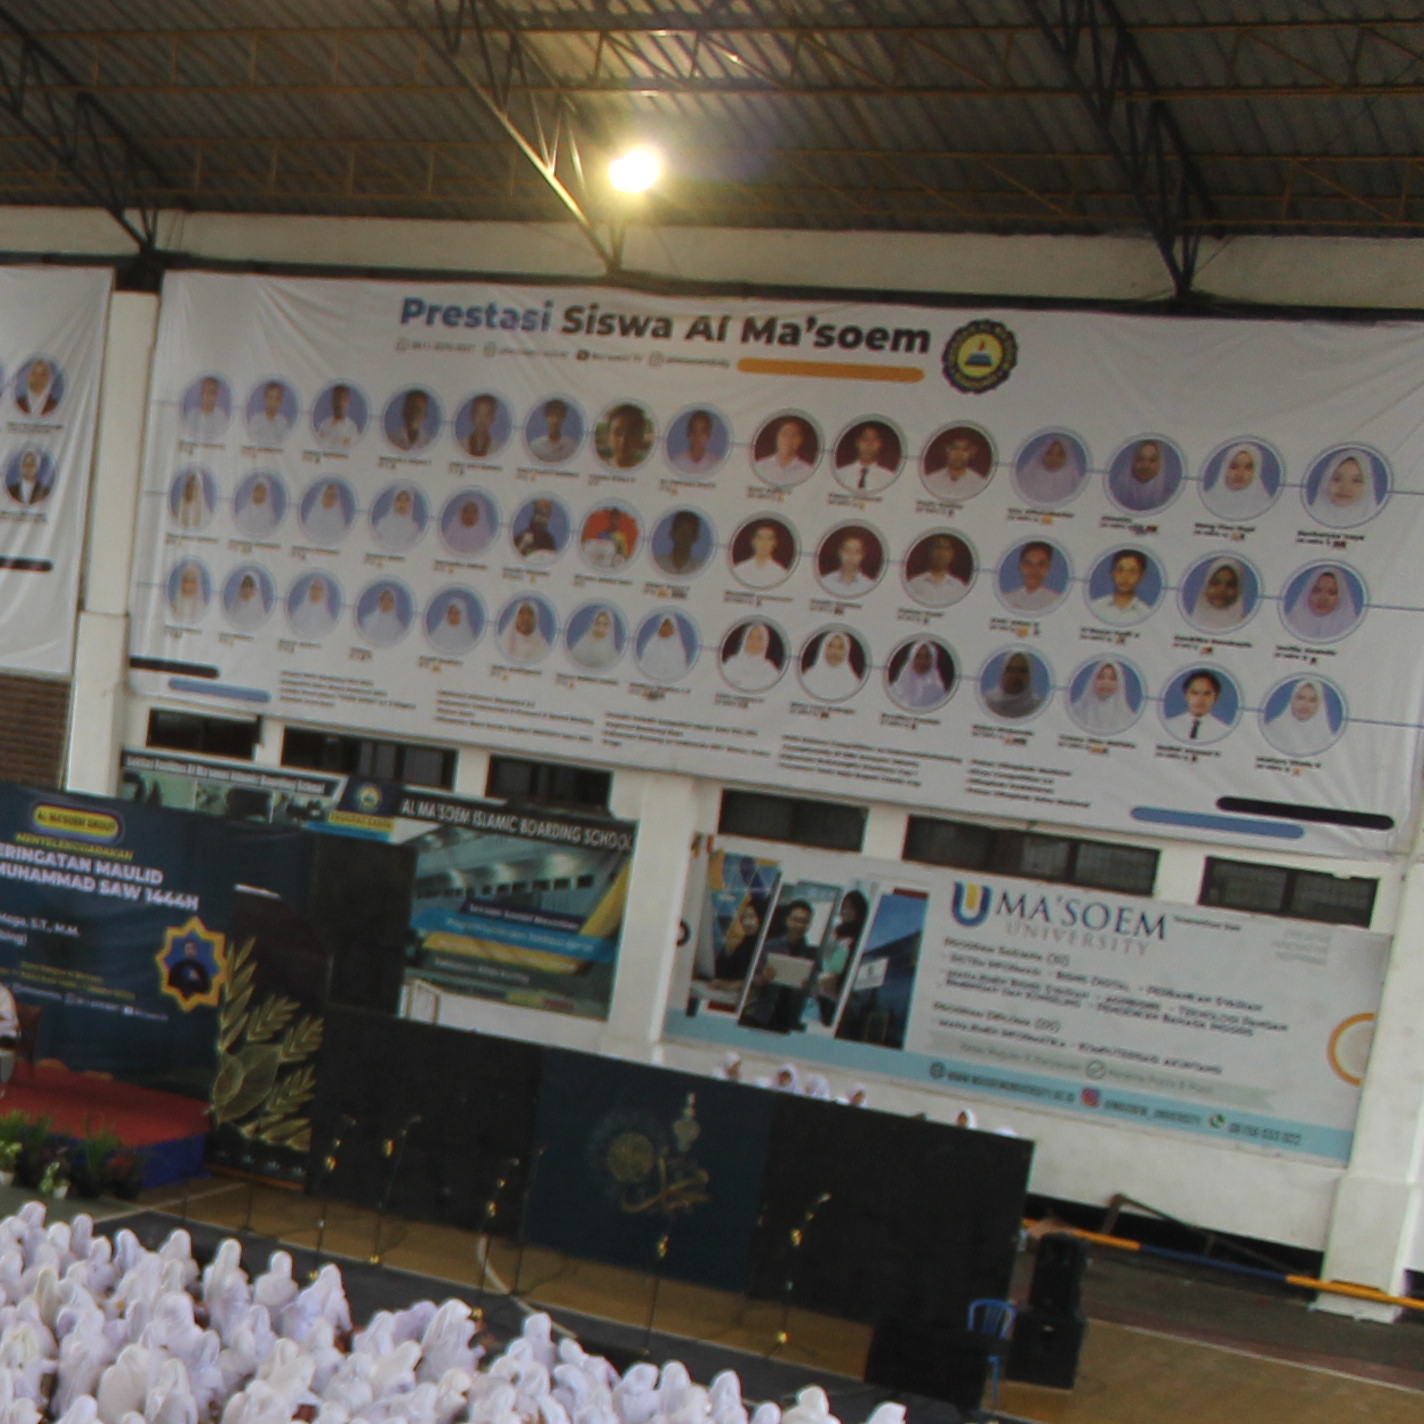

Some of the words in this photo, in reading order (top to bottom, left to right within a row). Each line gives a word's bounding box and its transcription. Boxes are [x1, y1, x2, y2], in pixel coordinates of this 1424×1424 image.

[401, 297, 550, 332] Prestasi
[562, 304, 671, 340] Siswa
[687, 313, 730, 343] Al
[741, 316, 930, 354] Ma'soem
[403, 799, 415, 816] AL
[418, 801, 470, 824] MA'SOEM
[473, 811, 517, 832] ISLAMIC
[520, 817, 581, 843] BOARDING
[94, 860, 164, 885] MAULID
[98, 878, 143, 901] SAW
[145, 887, 200, 912] 1444H
[996, 890, 1168, 941] MA'SOEM
[1004, 918, 1151, 957] UNIVERSITY
